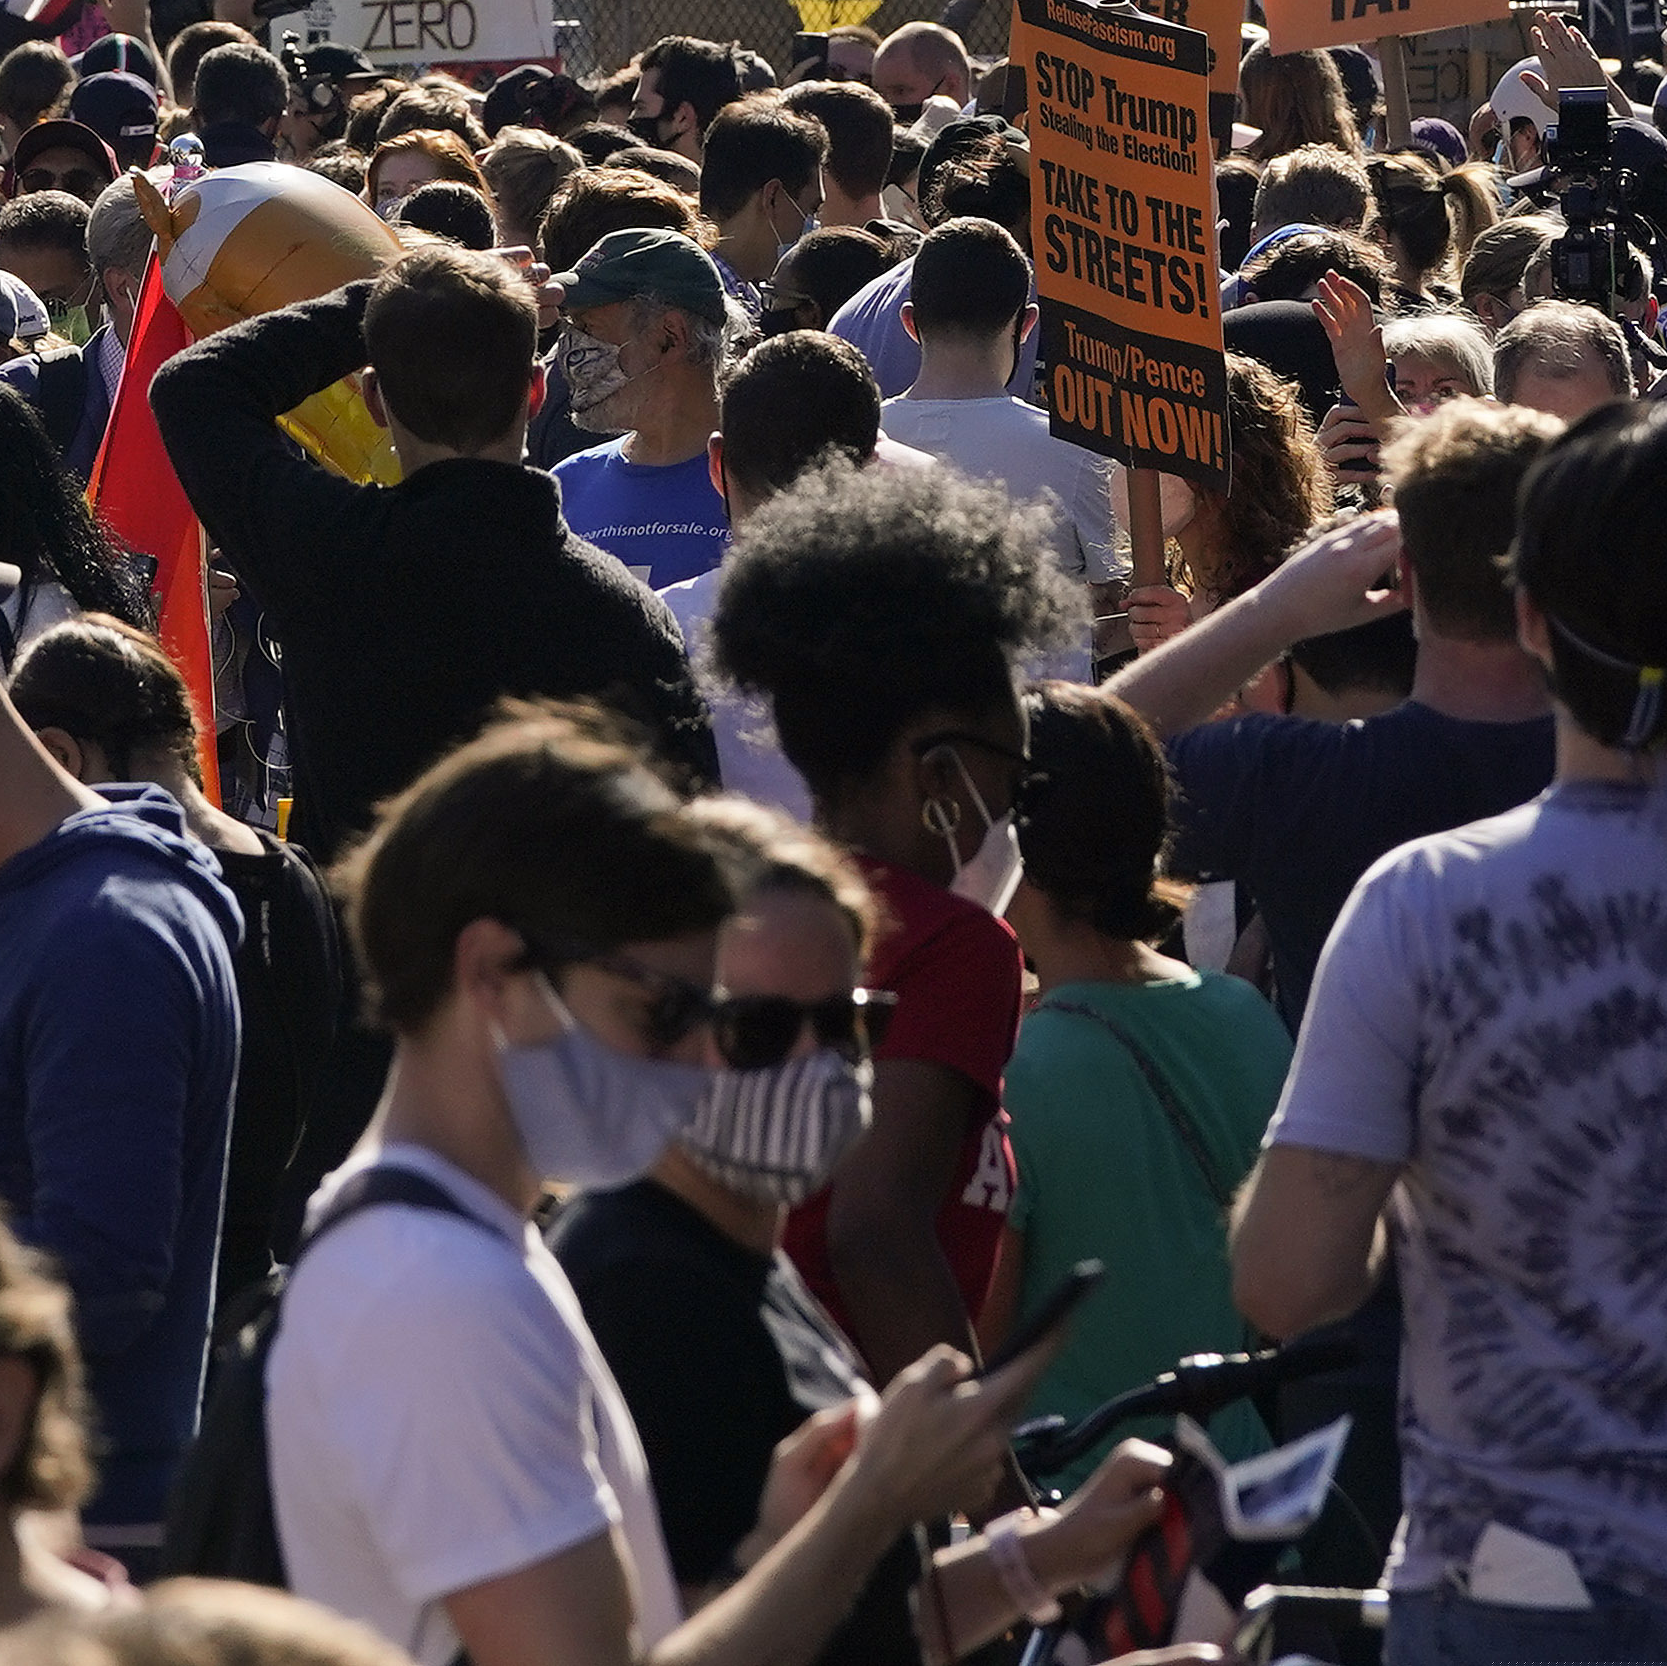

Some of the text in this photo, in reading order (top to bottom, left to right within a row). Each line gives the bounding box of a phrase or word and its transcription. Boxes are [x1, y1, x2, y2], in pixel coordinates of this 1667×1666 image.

[1034, 49, 1198, 154] STOP Trump
[1038, 102, 1198, 177] Stealing the Election!
[1038, 158, 1207, 257] TAKE TO THE
[1044, 212, 1211, 321] STREETS!
[1063, 319, 1206, 398] Trump/Pence
[1053, 363, 1225, 471] OUT NOW!
[580, 521, 734, 543] earthisnotforsale.org
